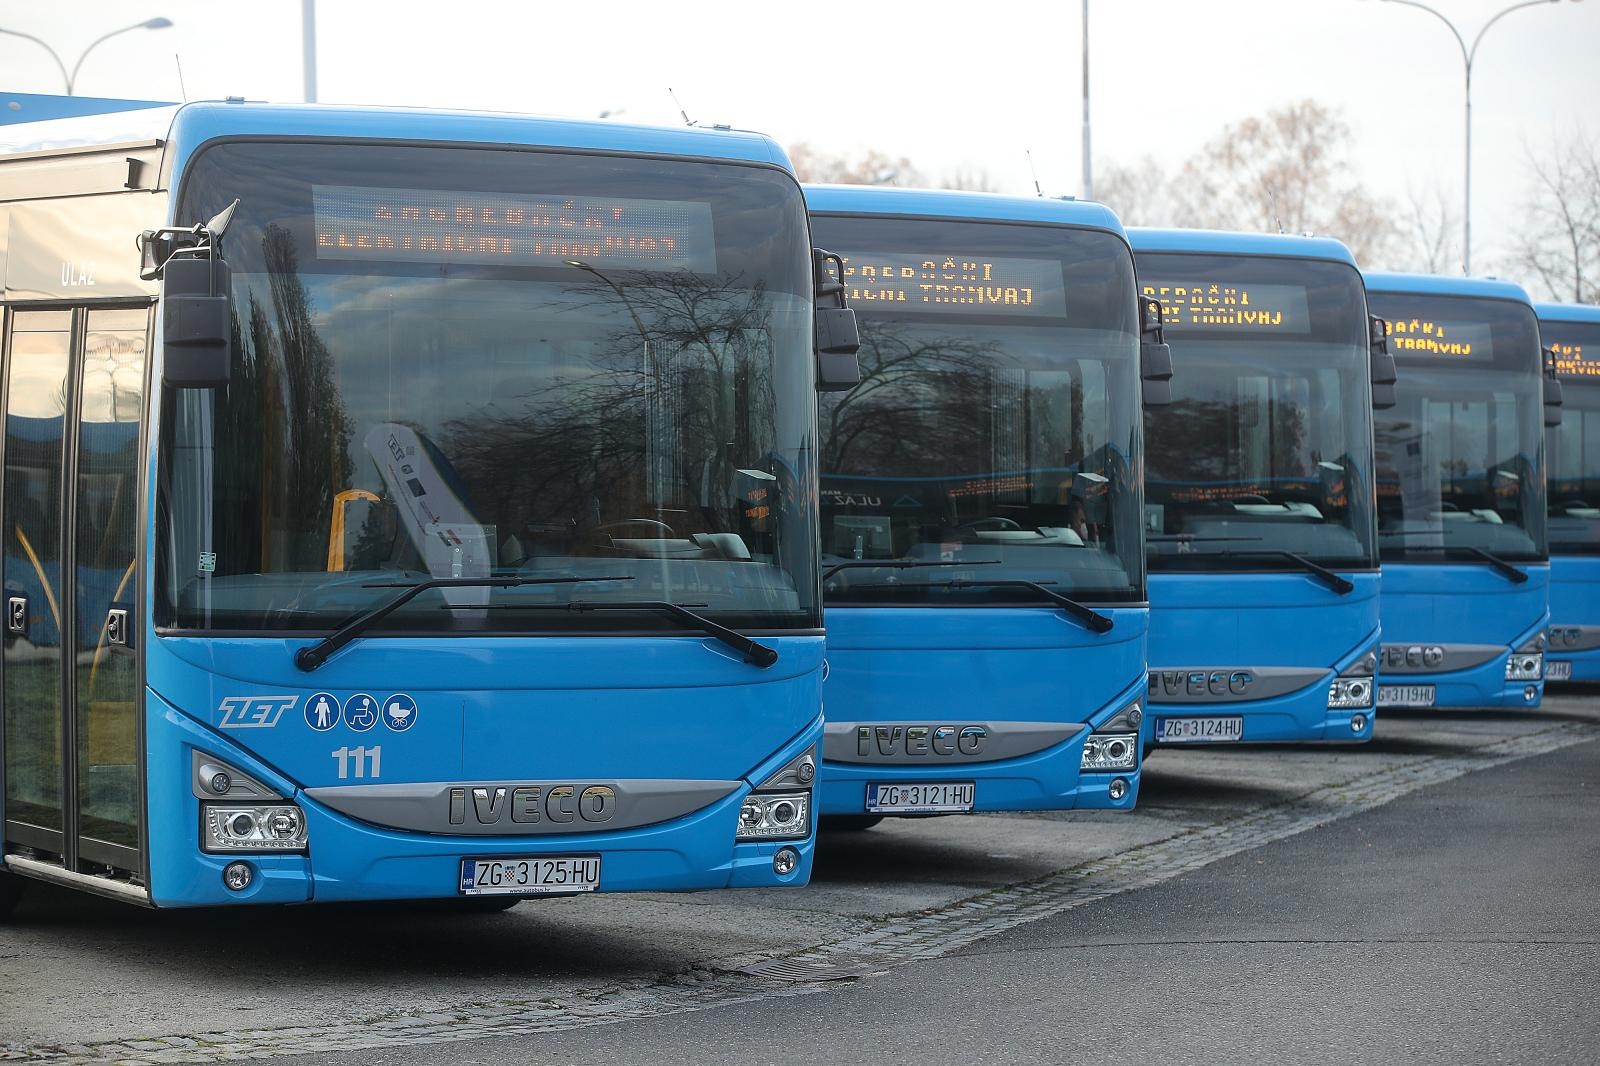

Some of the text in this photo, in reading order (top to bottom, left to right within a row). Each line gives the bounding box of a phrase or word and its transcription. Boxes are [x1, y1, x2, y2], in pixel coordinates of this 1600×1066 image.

[61, 261, 96, 287] ULAZ
[1148, 670, 1254, 696] IVECO
[218, 695, 300, 729] ZET
[857, 725, 988, 757] IVECO
[1166, 720, 1182, 736] ZG
[331, 745, 382, 779] 111
[448, 785, 617, 825] IVECO
[879, 787, 899, 805] ZG
[463, 878, 473, 886] HR
[477, 862, 503, 886] ZG
